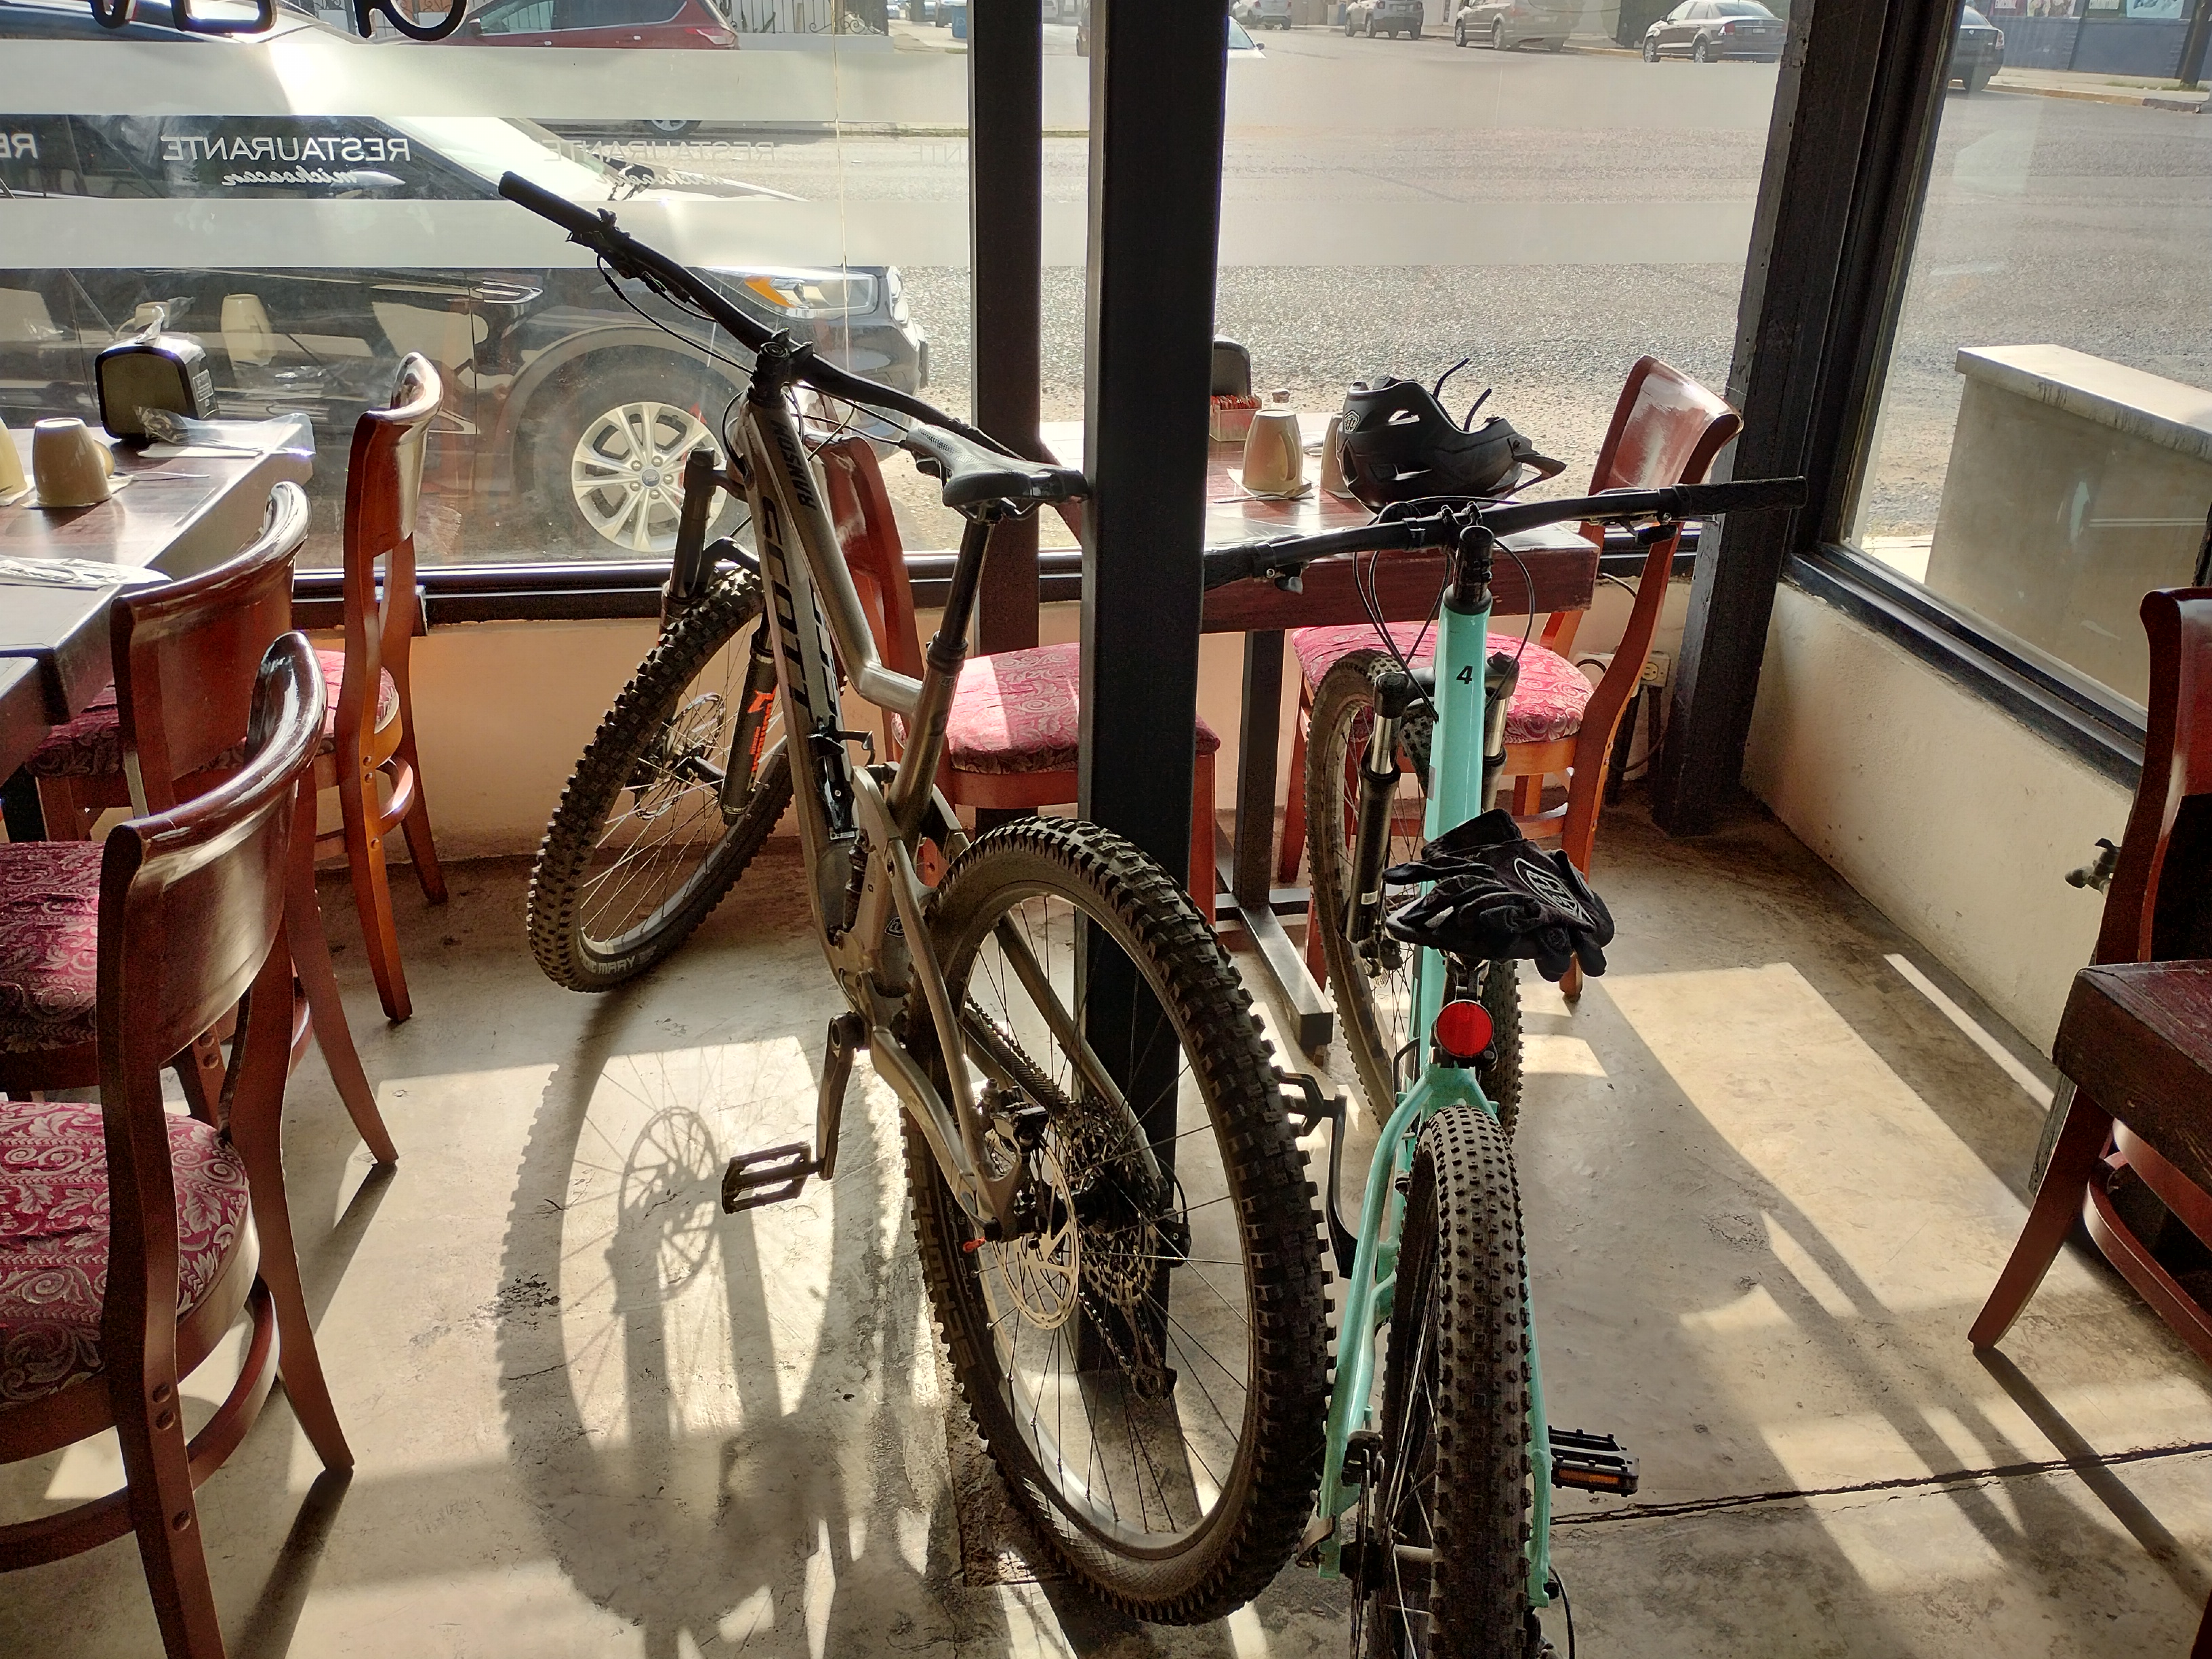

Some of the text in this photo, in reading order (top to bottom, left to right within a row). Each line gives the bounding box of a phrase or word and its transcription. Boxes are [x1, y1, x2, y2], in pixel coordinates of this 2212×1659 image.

[770, 419, 817, 511] RANSOM
[1456, 665, 1473, 684] 4
[598, 955, 636, 975] MARY
